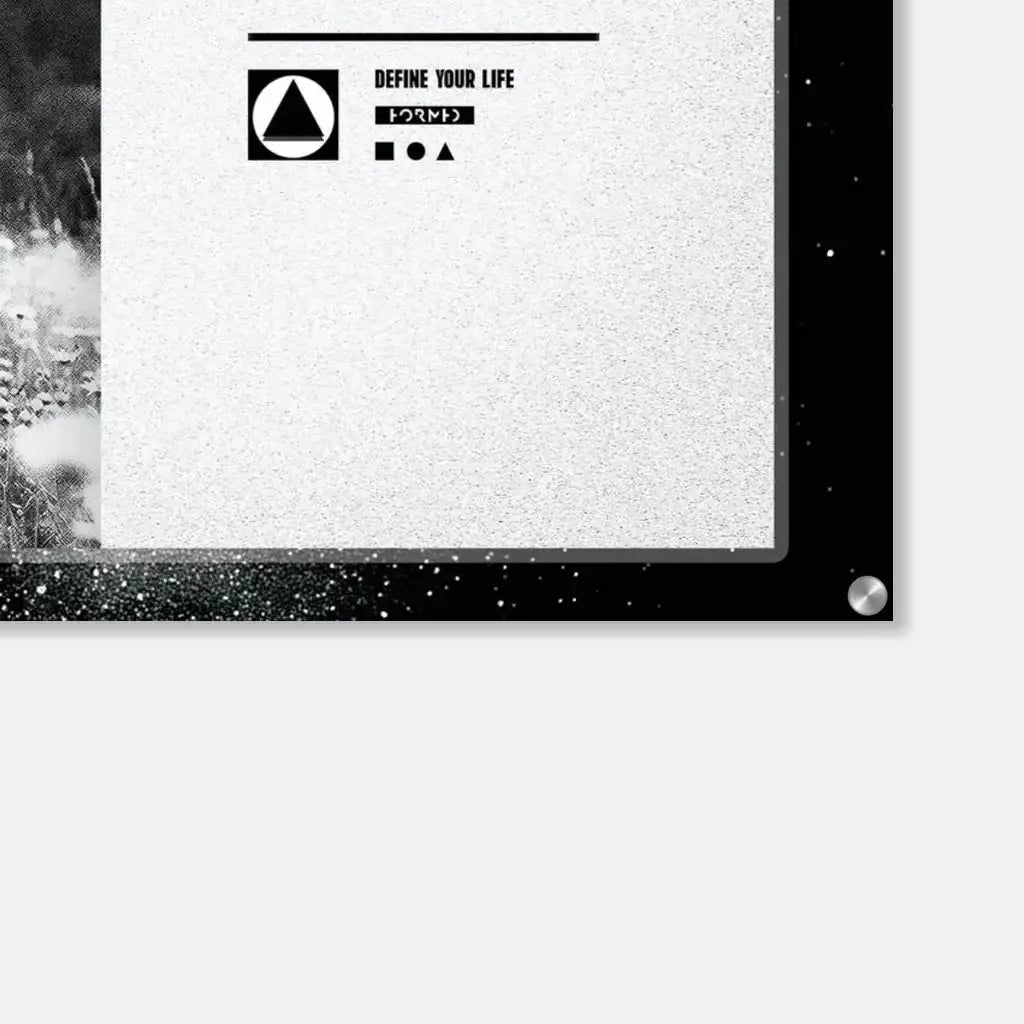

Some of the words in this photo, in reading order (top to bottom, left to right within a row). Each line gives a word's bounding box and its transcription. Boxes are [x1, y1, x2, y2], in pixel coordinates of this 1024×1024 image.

[374, 69, 429, 89] DEFINE
[435, 69, 476, 89] YOUR
[482, 69, 515, 89] LIFE
